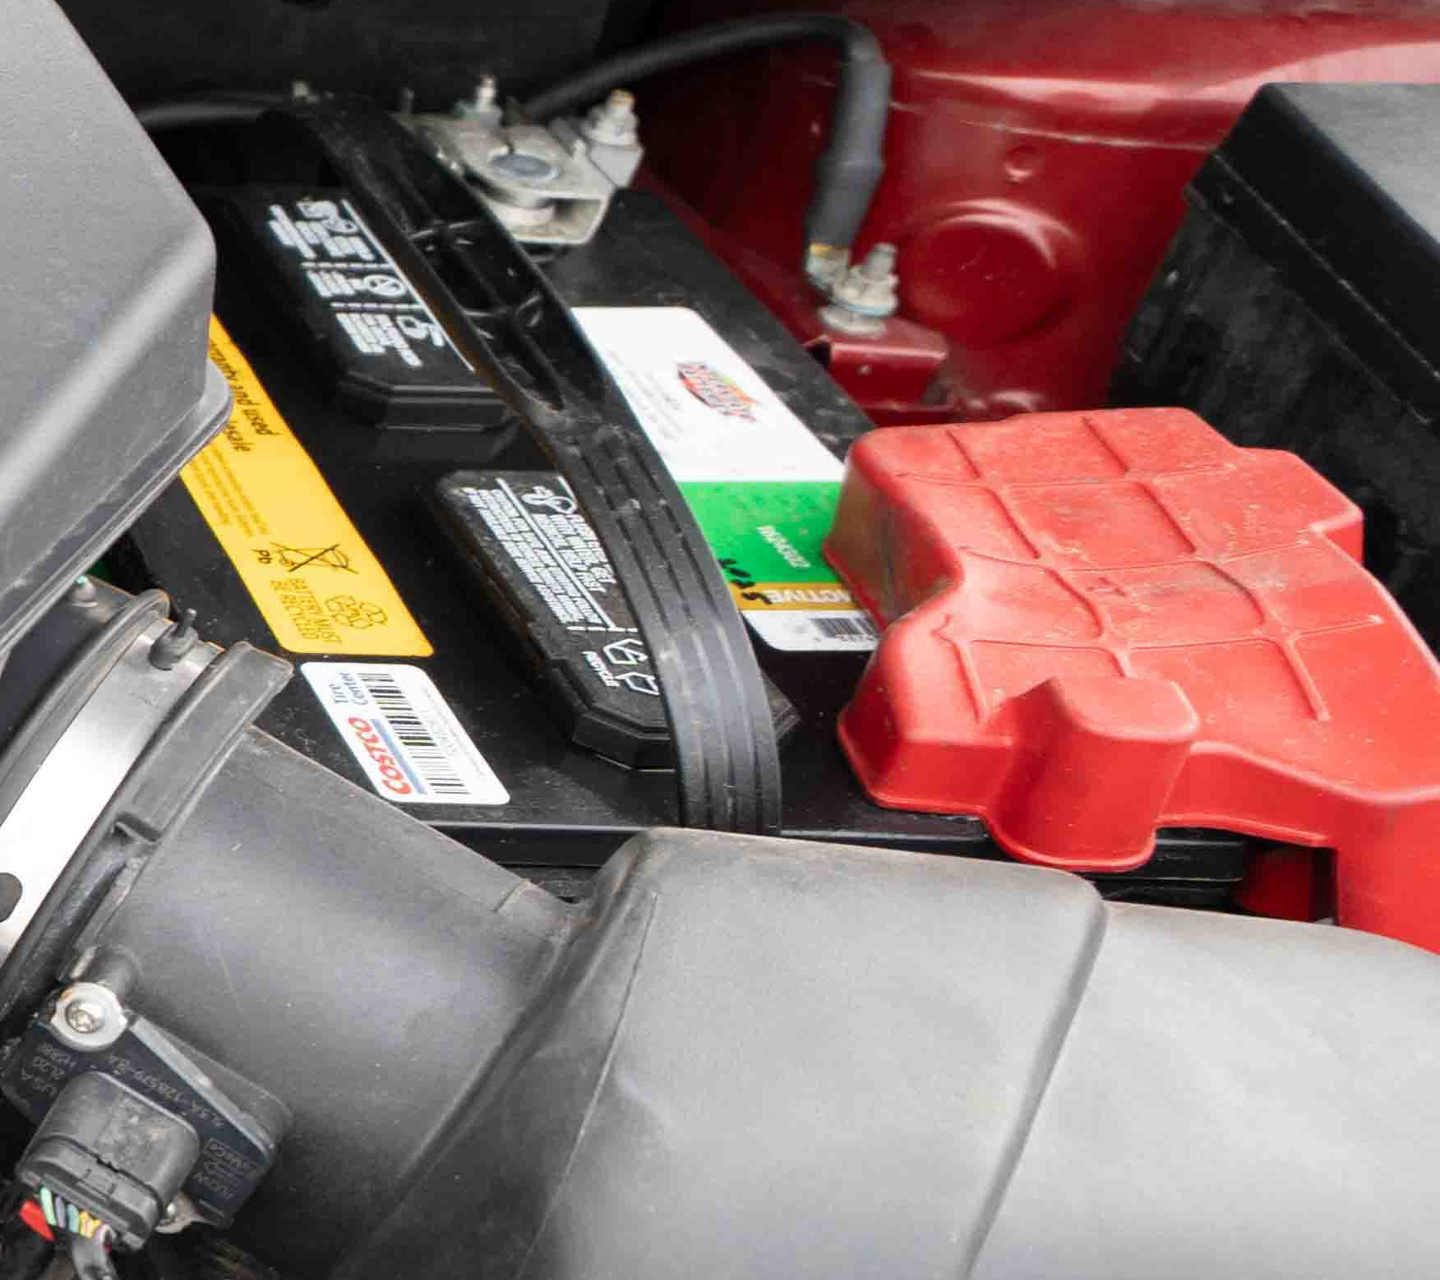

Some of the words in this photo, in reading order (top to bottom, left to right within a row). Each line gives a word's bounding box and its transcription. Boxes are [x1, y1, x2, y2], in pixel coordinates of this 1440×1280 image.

[322, 682, 351, 704] Tire
[333, 671, 372, 706] Center
[347, 716, 414, 795] COSTCO
